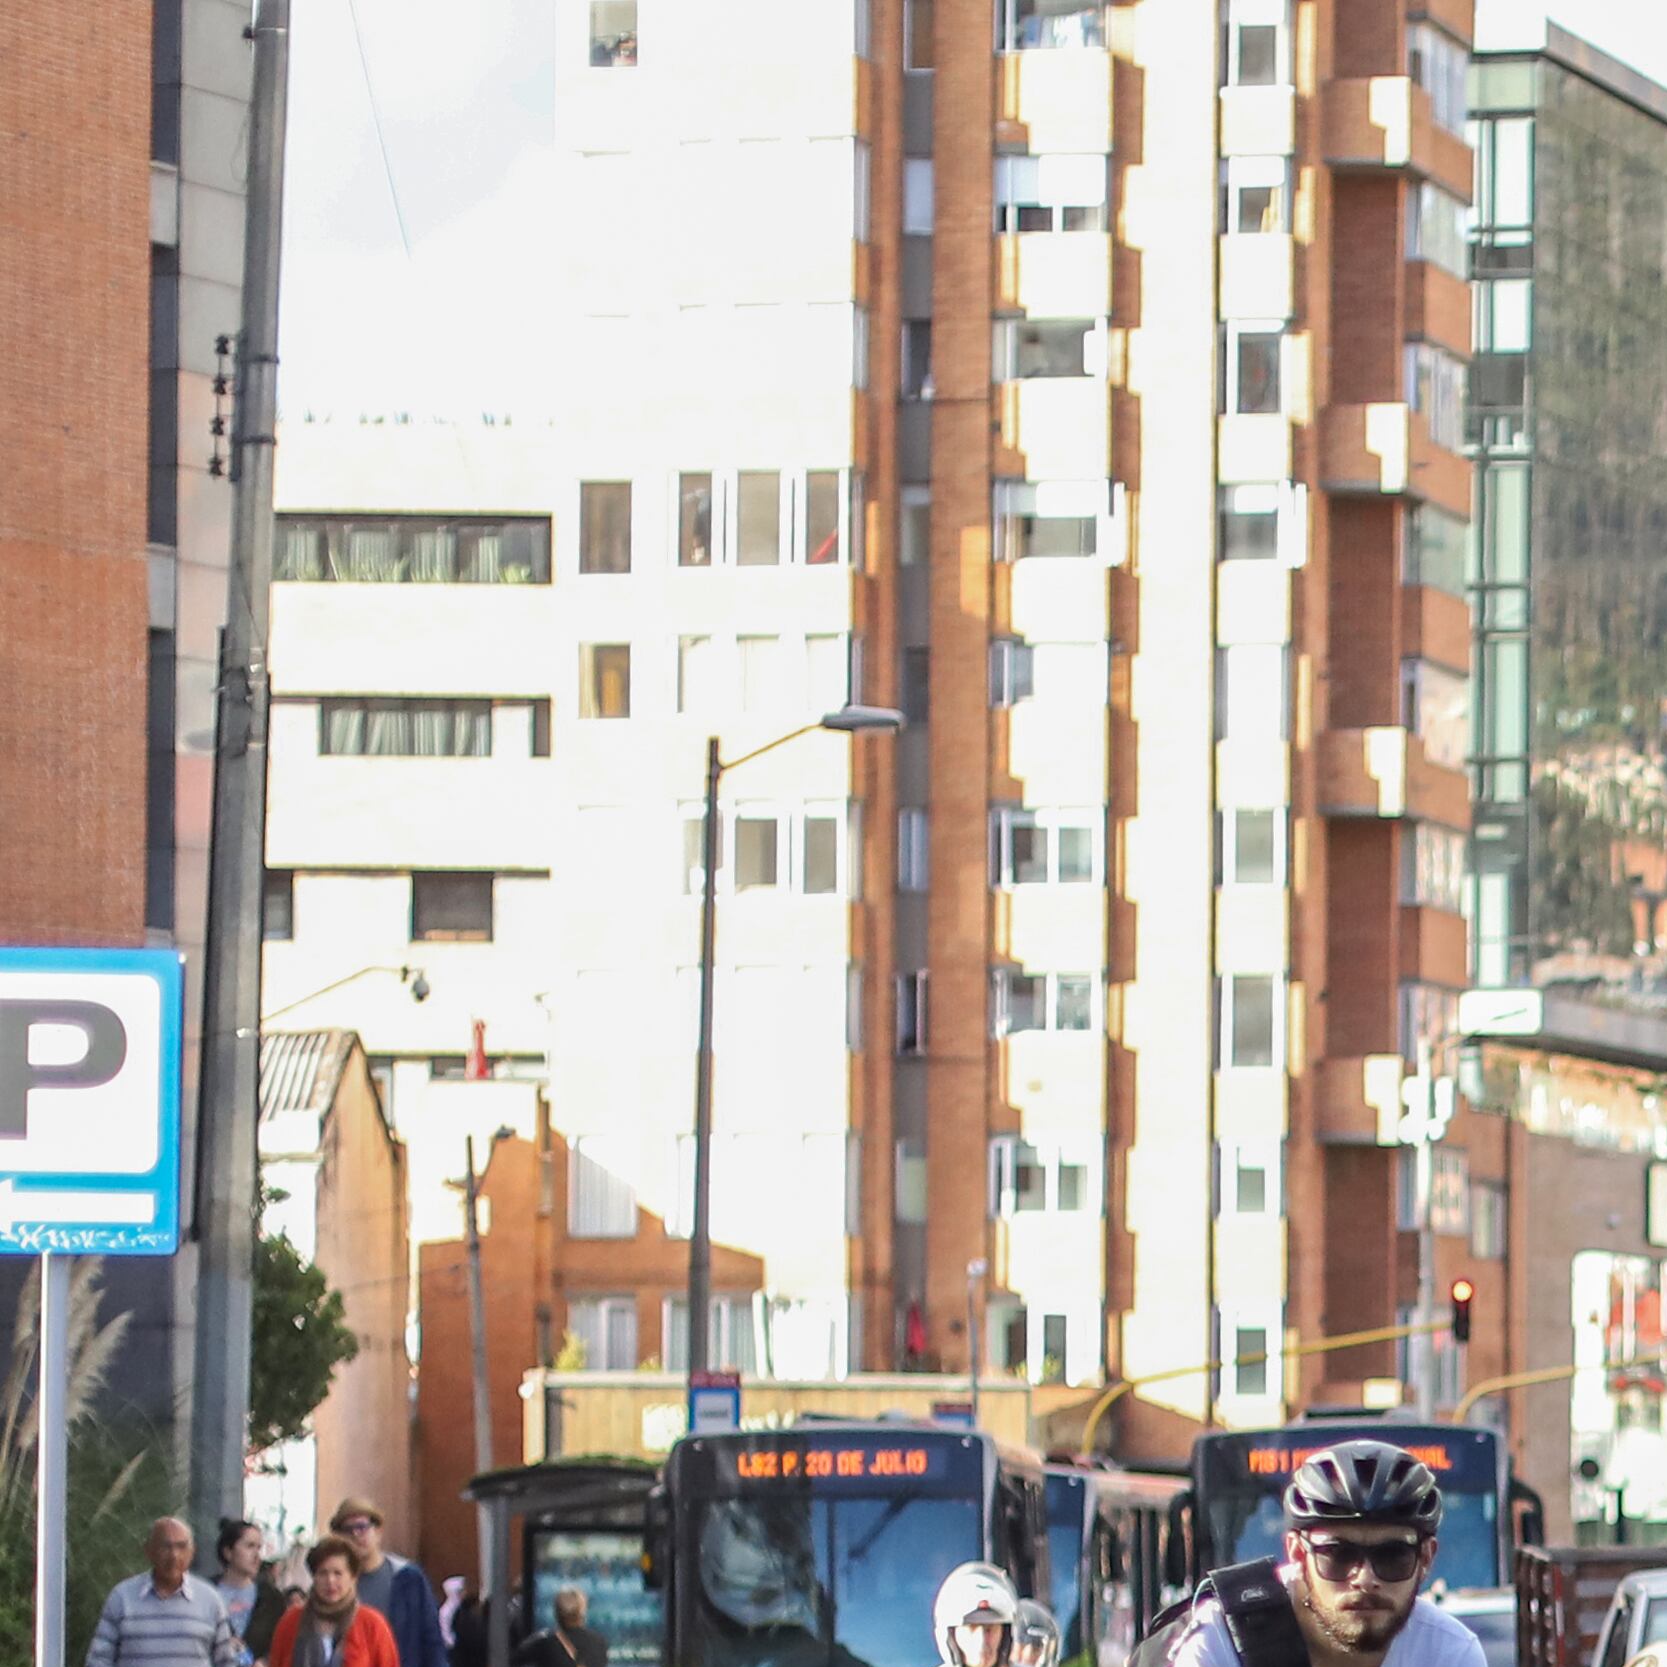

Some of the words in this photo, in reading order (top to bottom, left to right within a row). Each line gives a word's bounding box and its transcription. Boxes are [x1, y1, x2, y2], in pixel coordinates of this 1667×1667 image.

[0, 999, 127, 1140] P
[805, 1450, 833, 1476] 20
[836, 1450, 865, 1476] DE
[868, 1448, 928, 1476] JULIO
